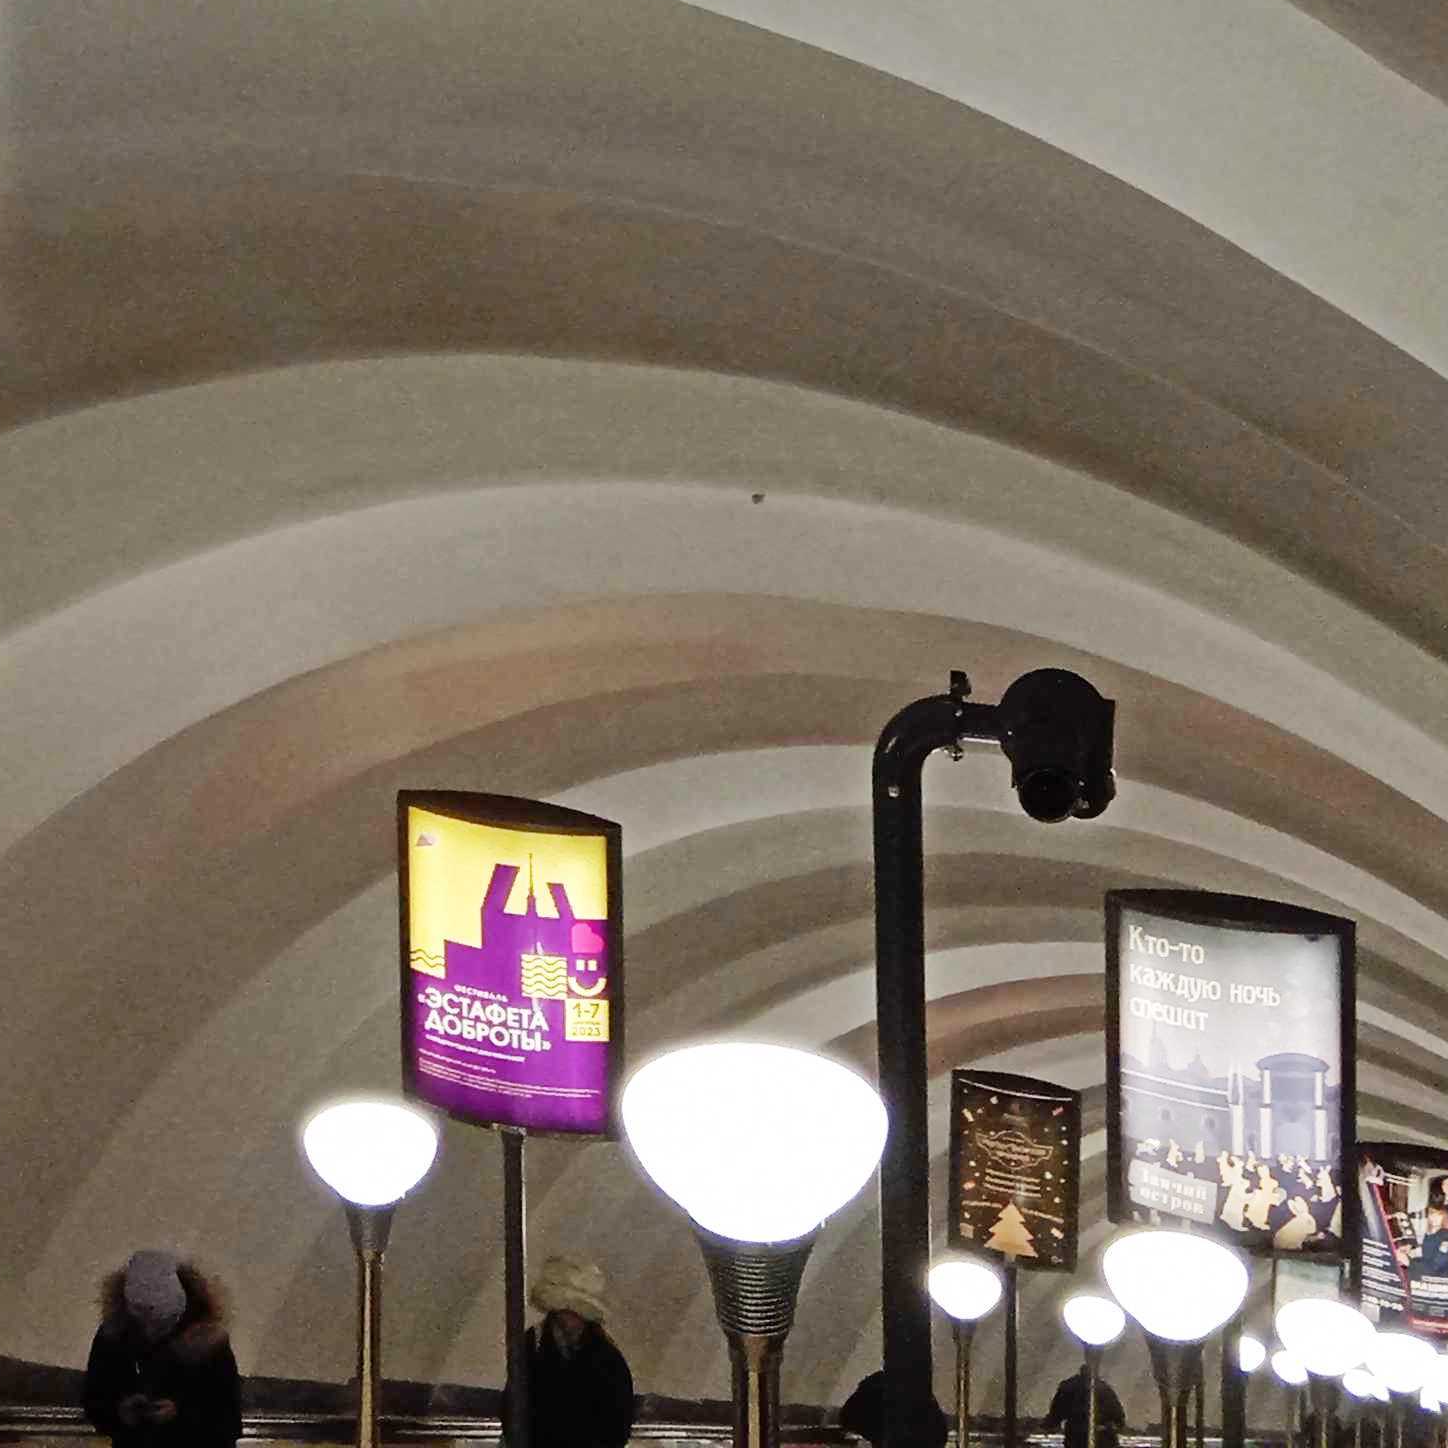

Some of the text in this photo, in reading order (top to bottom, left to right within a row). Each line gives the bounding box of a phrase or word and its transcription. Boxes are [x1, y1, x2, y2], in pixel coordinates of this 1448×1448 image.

[1128, 924, 1205, 965] Кто-то
[1129, 963, 1281, 1007] каждую ночь
[417, 986, 550, 1032] «ЭСТАФЕТА
[424, 1008, 552, 1052] ДОБРОТЫ»
